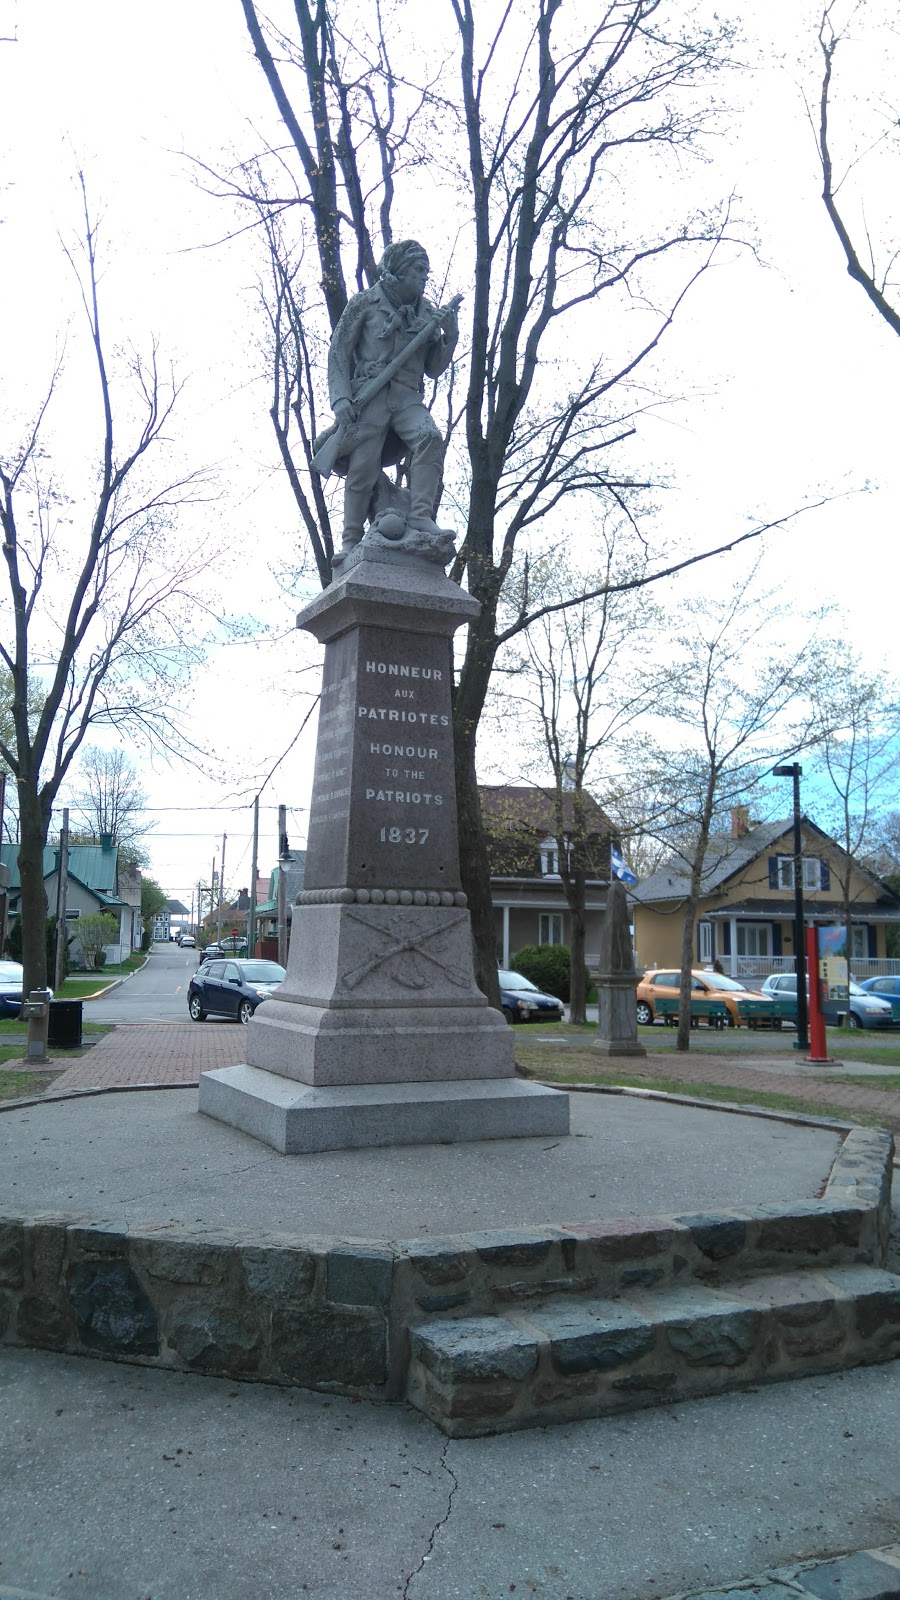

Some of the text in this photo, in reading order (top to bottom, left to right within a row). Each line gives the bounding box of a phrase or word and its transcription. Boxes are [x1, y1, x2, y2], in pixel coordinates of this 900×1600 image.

[366, 661, 442, 681] HONNEUR
[394, 689, 415, 698] AUX
[358, 706, 449, 726] PATRIOTES
[370, 743, 438, 759] HONOUR
[385, 768, 425, 780] TO THE
[365, 788, 443, 806] PATRIOTS
[380, 826, 429, 844] 1837
